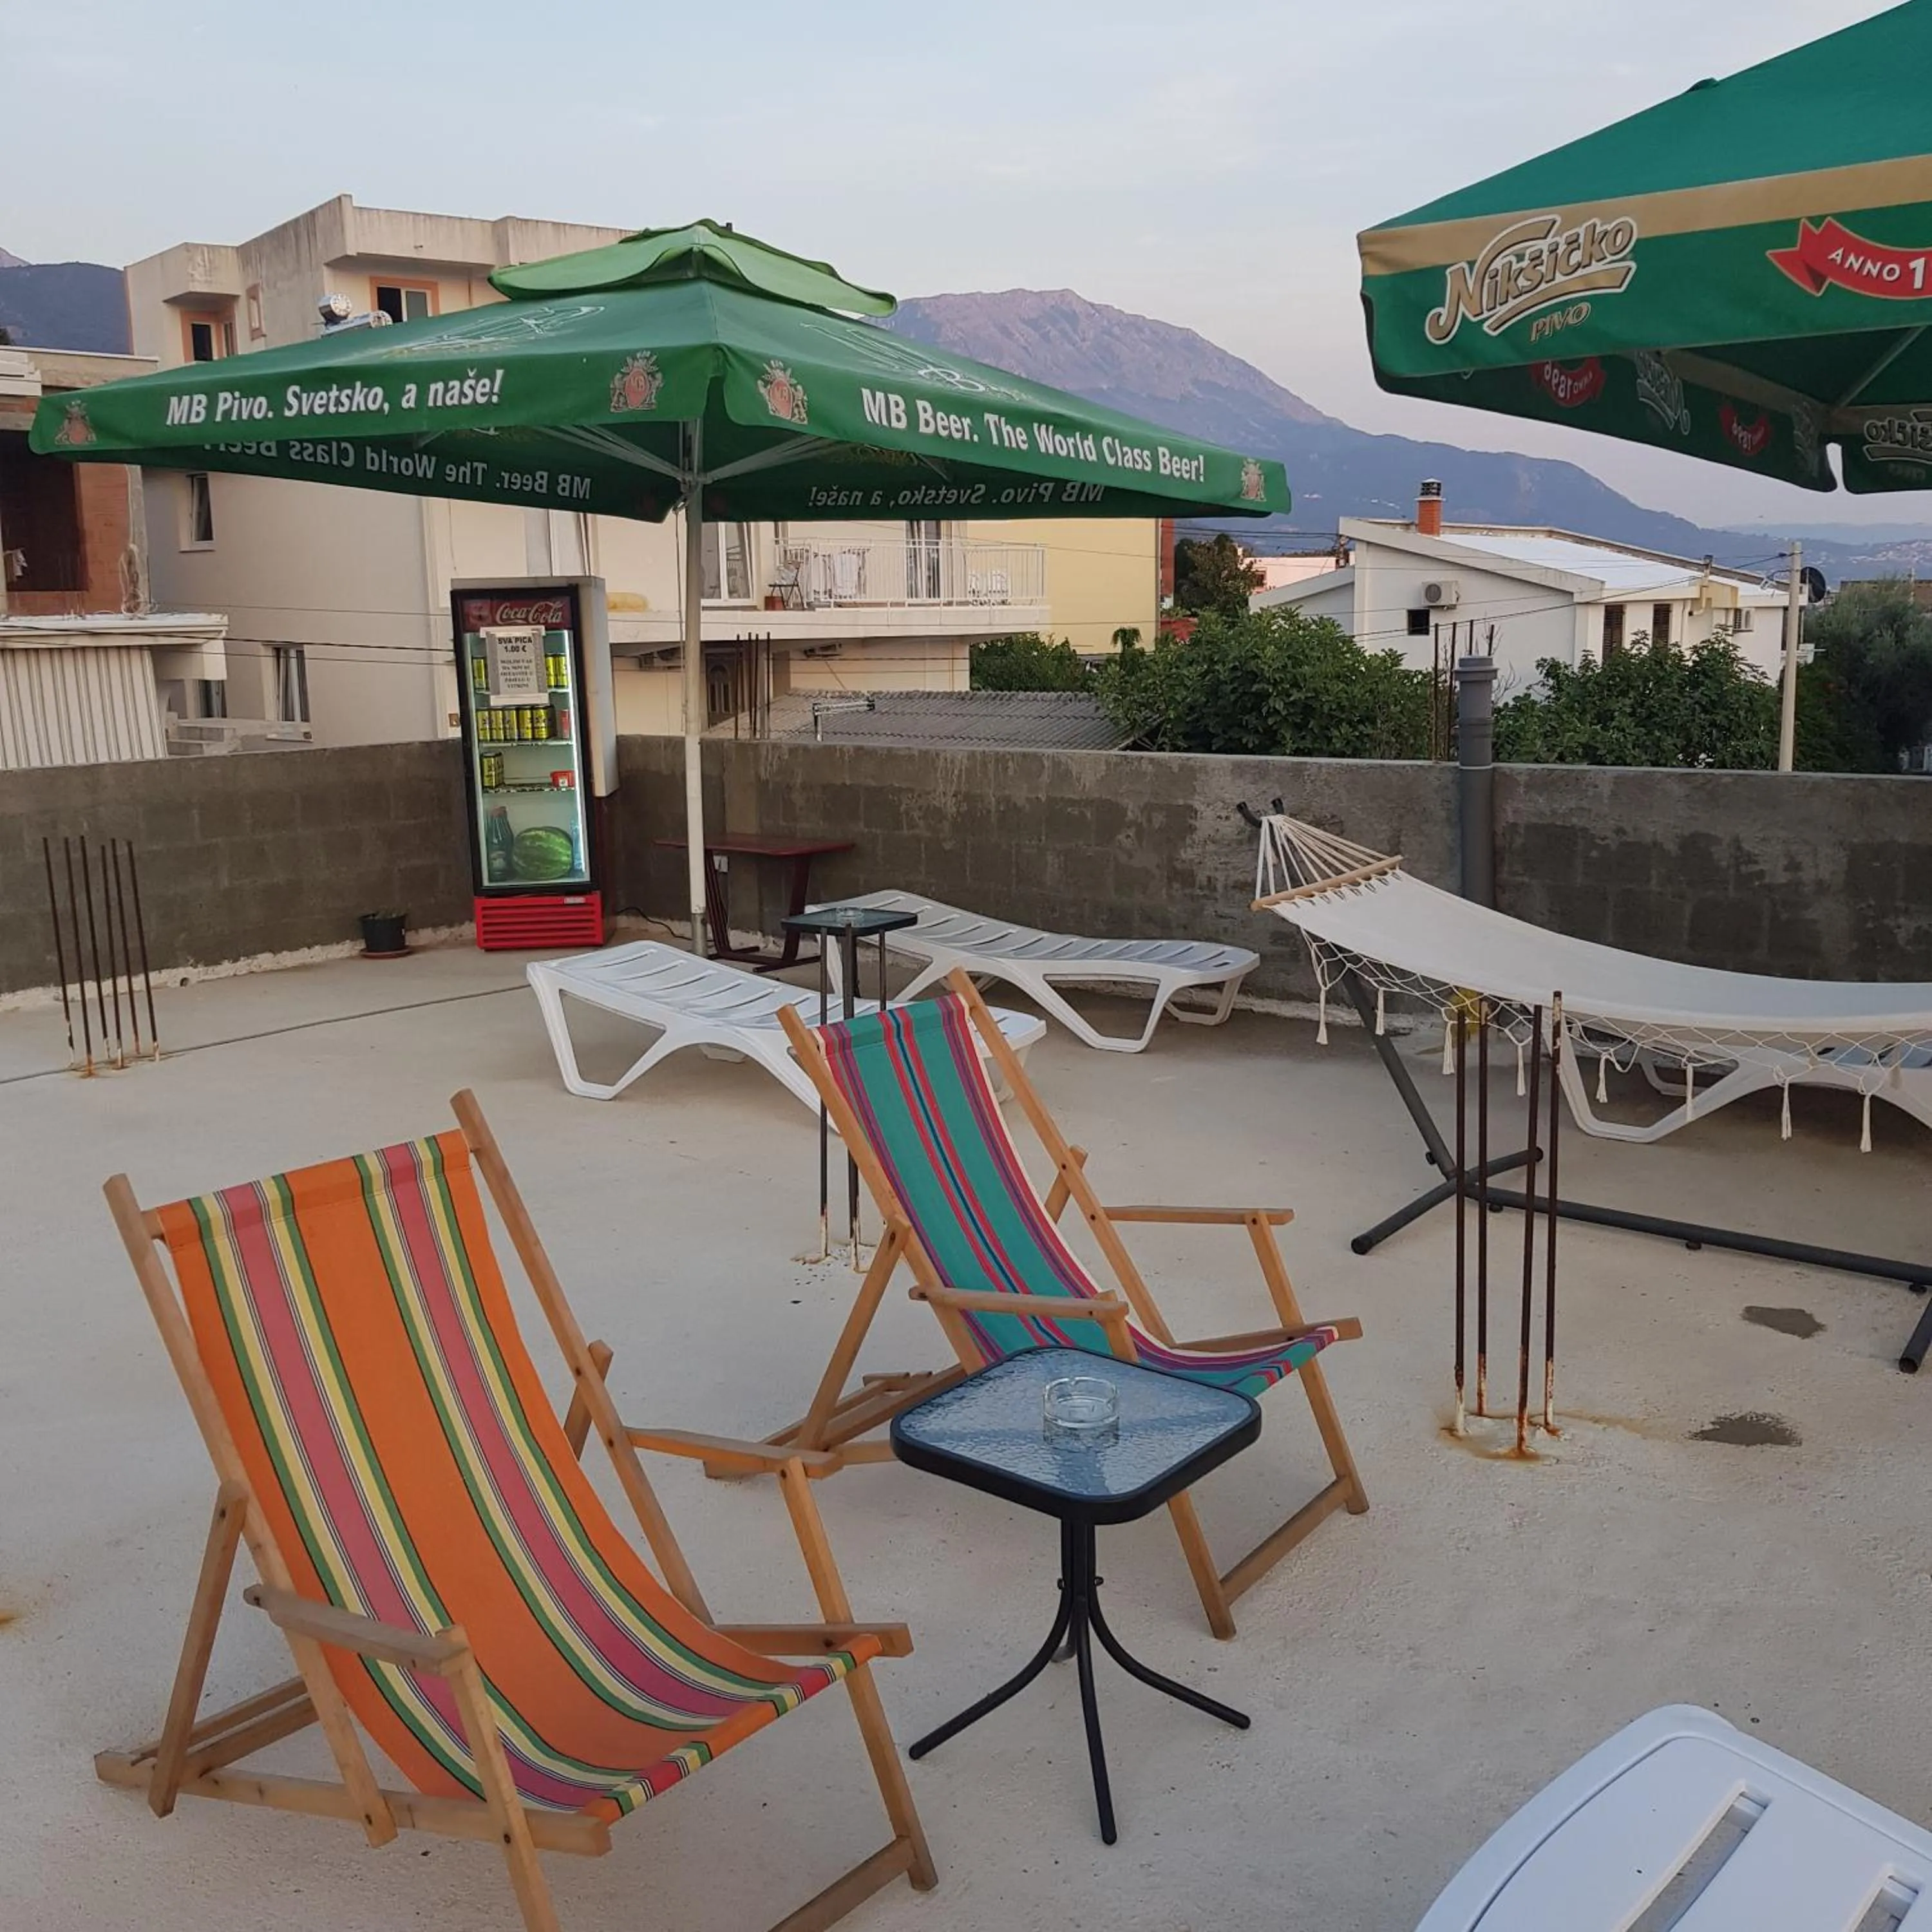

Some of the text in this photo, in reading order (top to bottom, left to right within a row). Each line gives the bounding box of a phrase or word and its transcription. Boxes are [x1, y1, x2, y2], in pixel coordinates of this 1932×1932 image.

[1425, 214, 1638, 345] Nikšičko
[1828, 247, 1927, 290] ANNO 1
[1530, 302, 1592, 344] PIVO
[166, 368, 504, 426] MB Pivo. Svetsko, a naše!
[861, 388, 1204, 482] MB Beer. The World Class Beer!
